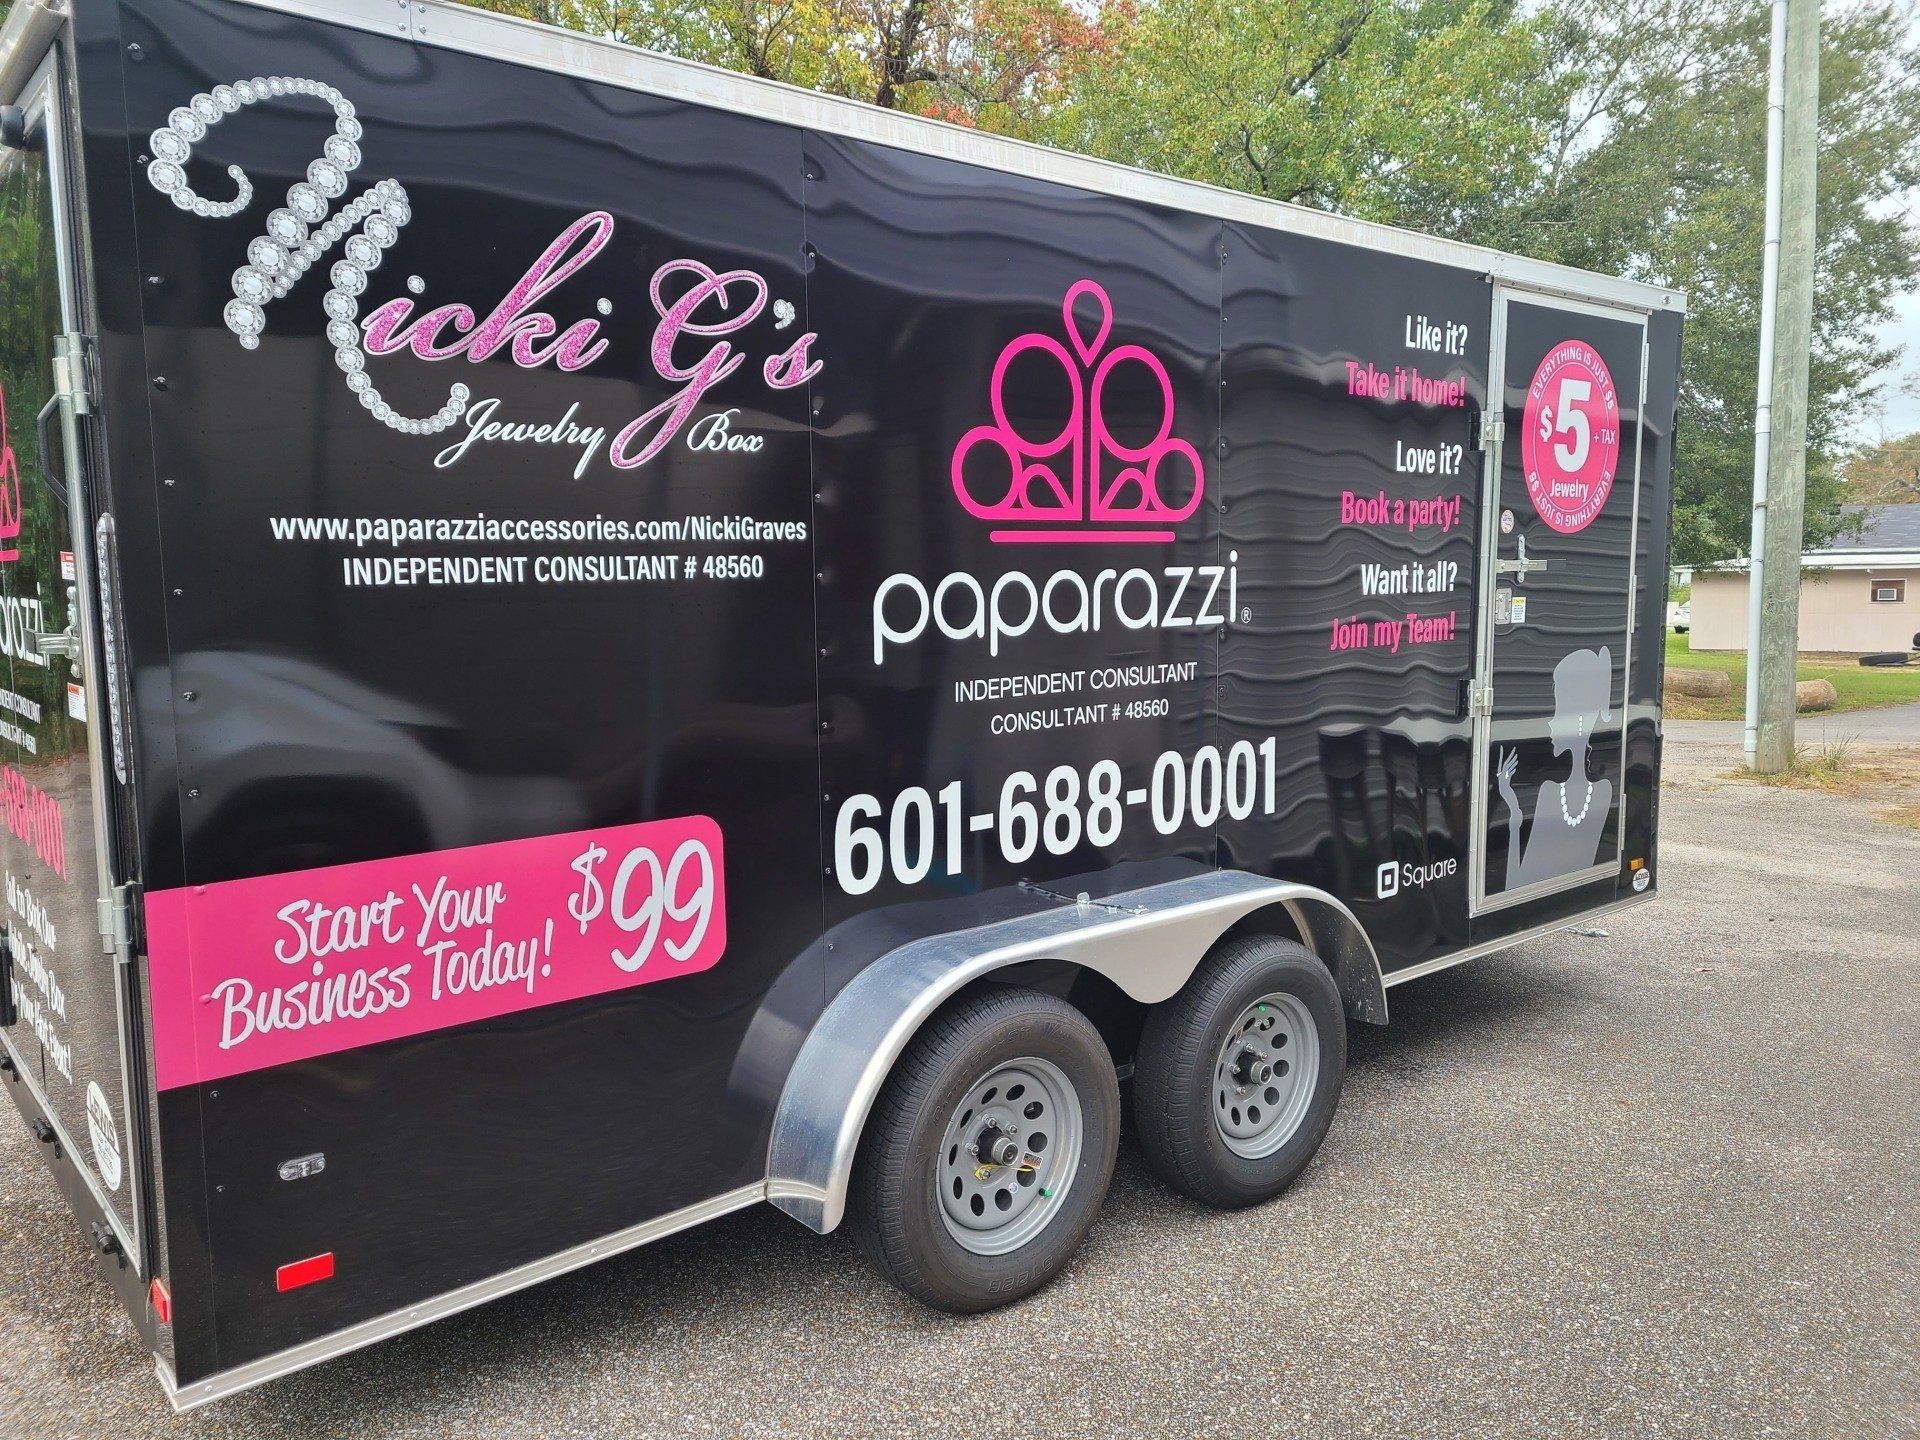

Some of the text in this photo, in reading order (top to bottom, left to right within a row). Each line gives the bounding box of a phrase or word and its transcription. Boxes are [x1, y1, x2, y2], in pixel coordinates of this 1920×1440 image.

[148, 76, 824, 469] Nicki G's
[1406, 315, 1468, 355] Like it?
[1345, 361, 1466, 407] Take it home!
[1533, 346, 1582, 399] EVERYTHING
[1583, 351, 1592, 365] IS
[1591, 360, 1609, 388] JUST
[434, 398, 764, 480] Jewelry Box
[1396, 440, 1463, 475] Love it?
[1601, 429, 1615, 444] TAX
[1341, 490, 1390, 524] Book
[1393, 499, 1404, 524] a
[1409, 495, 1461, 533] party!
[1536, 492, 1555, 519] JUST
[1550, 479, 1589, 502] Jewelry
[1564, 471, 1611, 527] EVERYTHING
[269, 513, 807, 546] www.paparazziaccessories.com/NickiGraves
[1555, 512, 1563, 527] IS
[343, 554, 764, 586] INDEPENDENT CONSULTANT # 48560
[1361, 561, 1458, 596] Want it all?
[873, 549, 1238, 666] paparazzi
[1331, 611, 1456, 654] Join my Team!
[955, 662, 1198, 703] INDEPENDENT CONSULTANT
[991, 698, 1169, 735] CONSULTANT # 48560
[834, 736, 1276, 895] 601-688-0001
[1402, 858, 1457, 889] Square
[275, 876, 506, 965] Start Your
[568, 839, 715, 973] $99
[210, 918, 555, 1050] Business Today!
